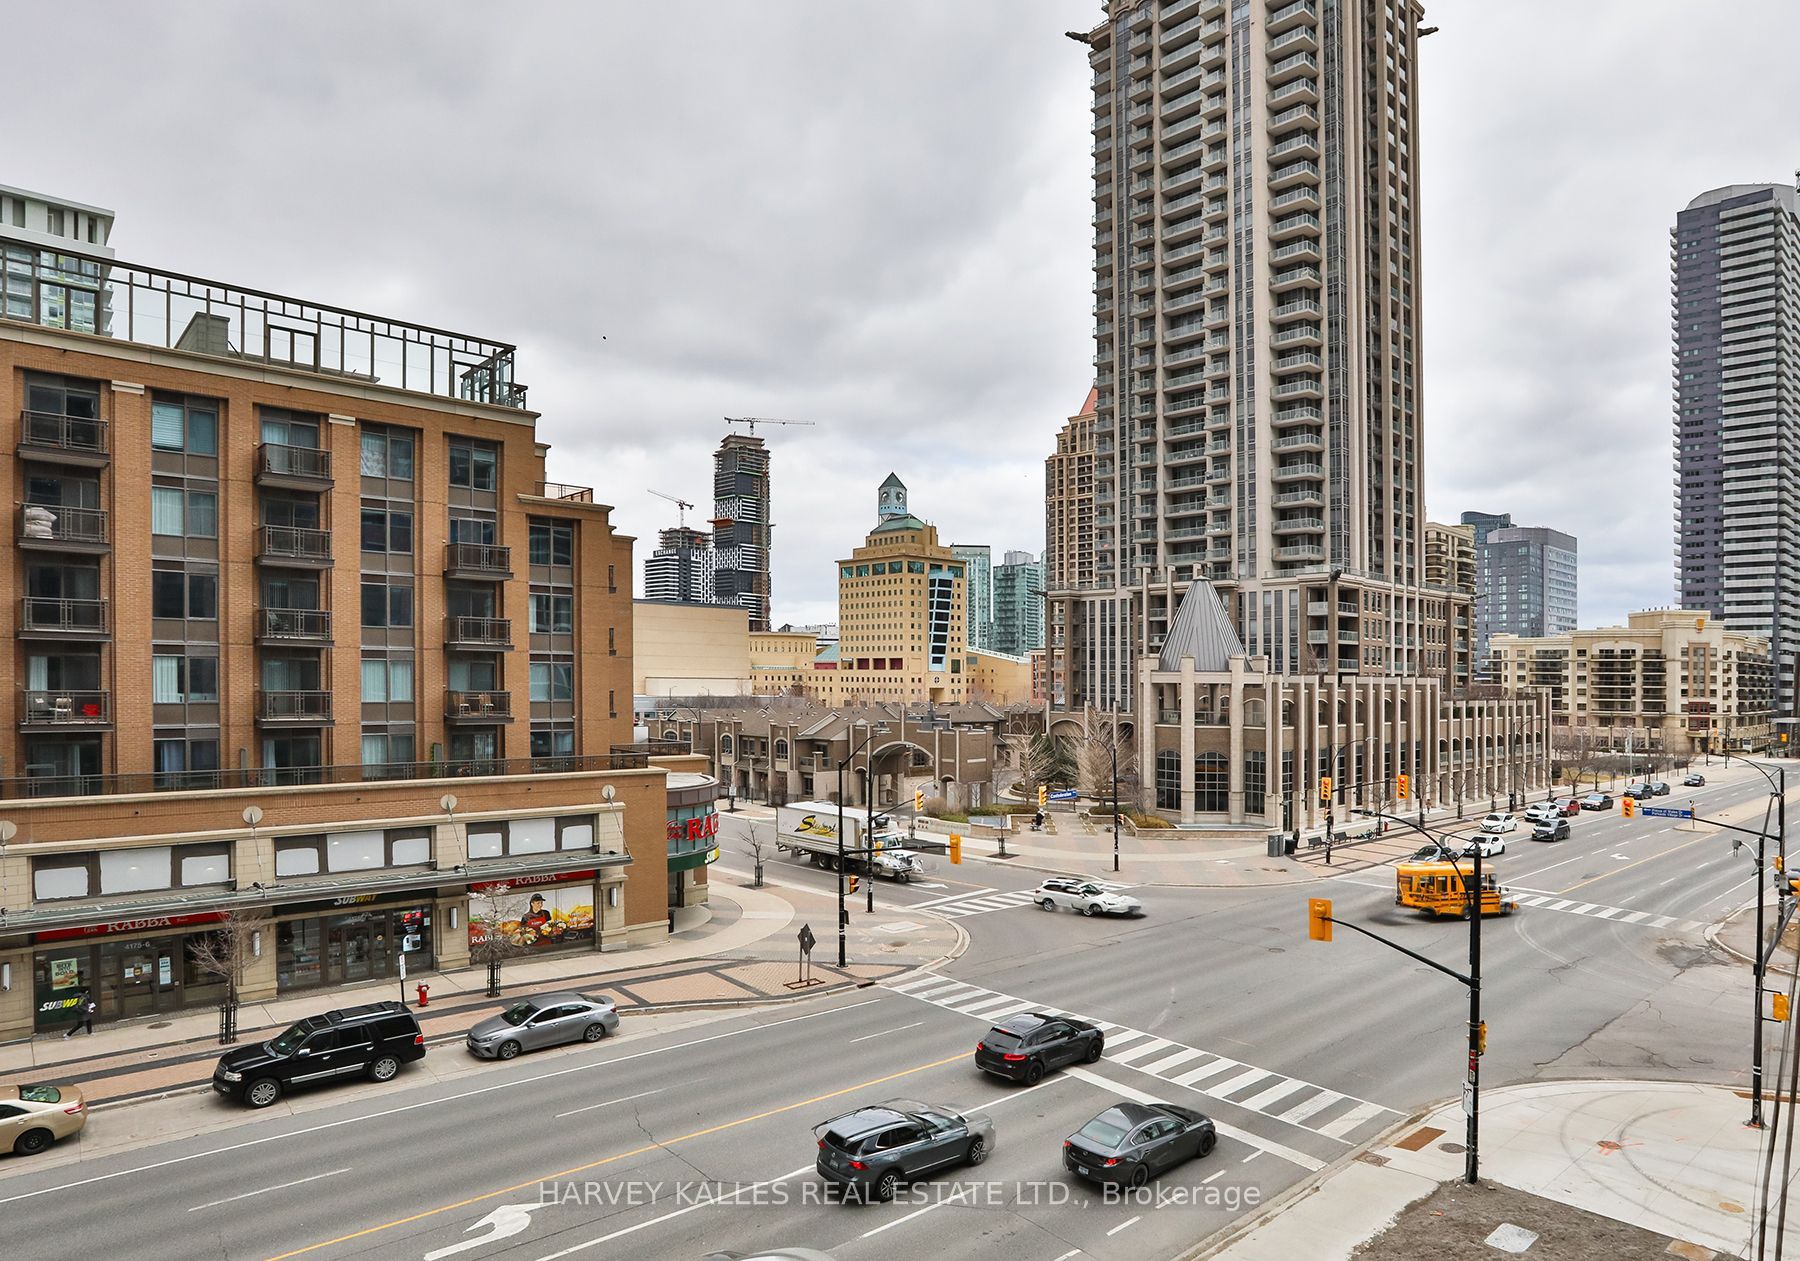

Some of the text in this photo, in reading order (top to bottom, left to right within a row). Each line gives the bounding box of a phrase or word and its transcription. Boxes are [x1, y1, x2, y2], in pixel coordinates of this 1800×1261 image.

[515, 874, 557, 885] RABBA
[333, 894, 378, 906] SUBWAY
[106, 917, 172, 933] RABBA
